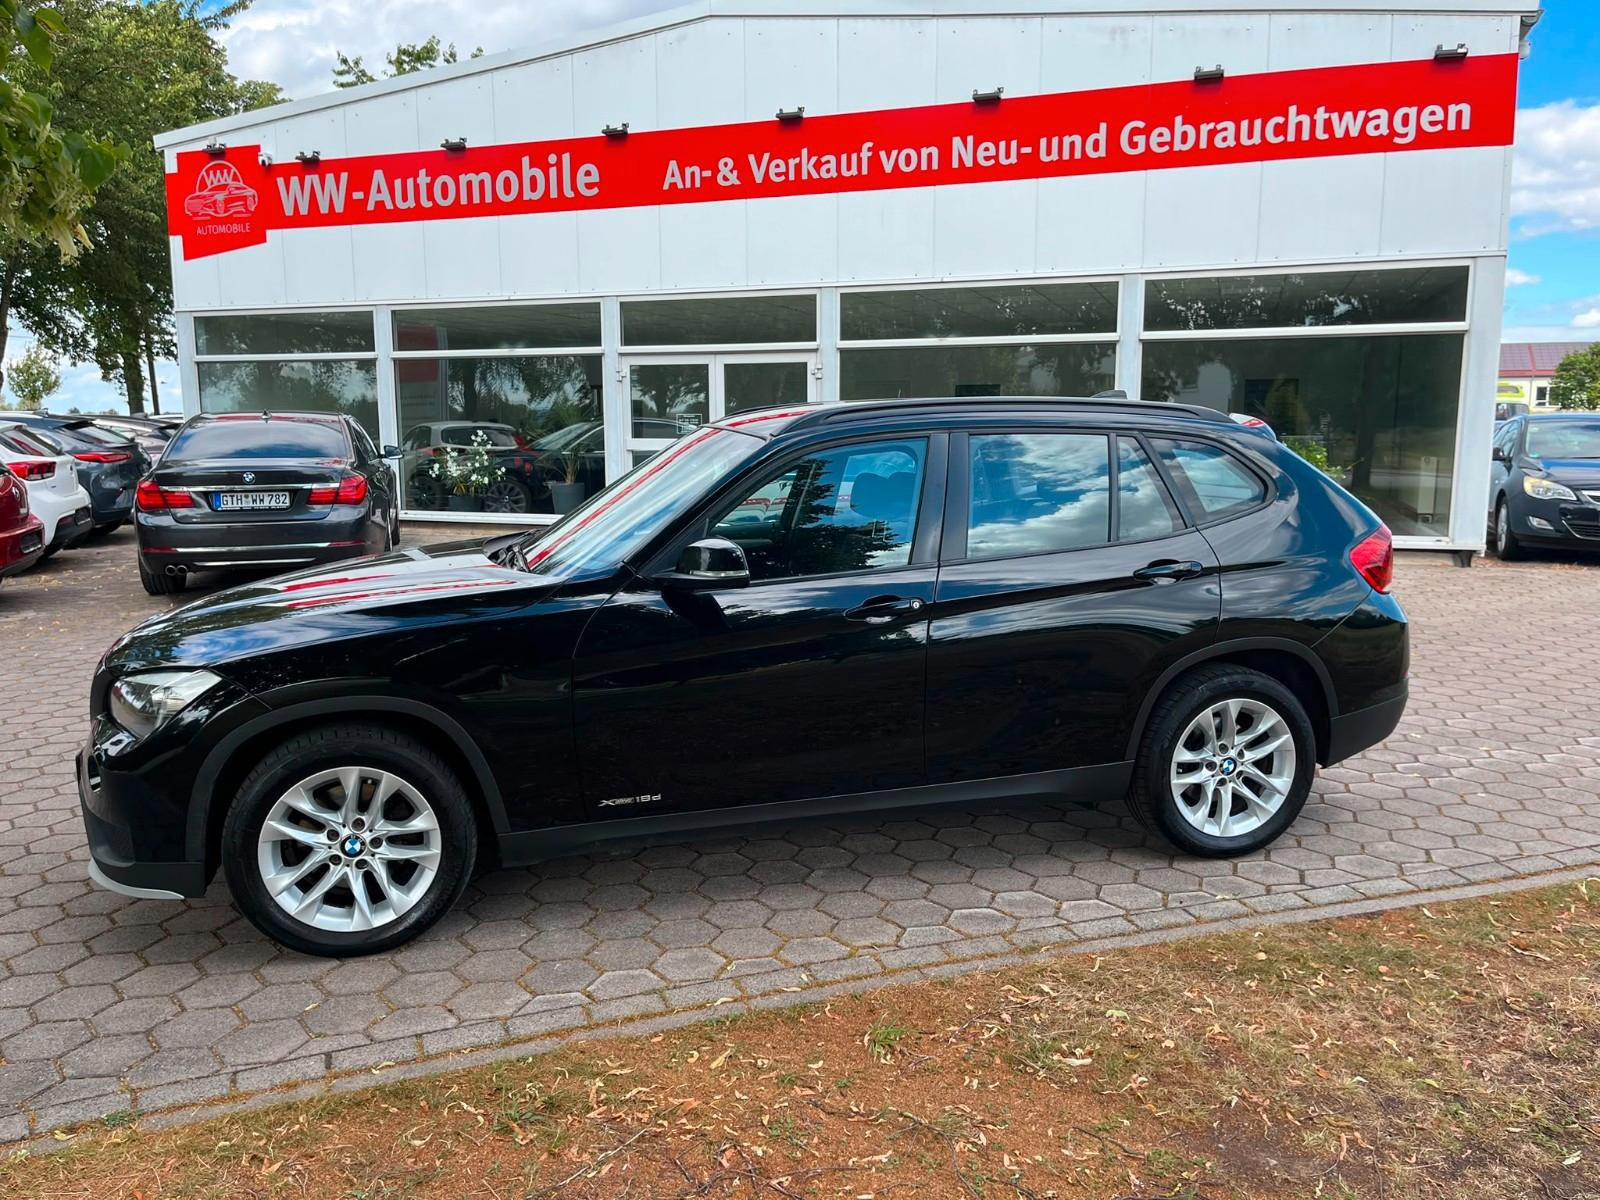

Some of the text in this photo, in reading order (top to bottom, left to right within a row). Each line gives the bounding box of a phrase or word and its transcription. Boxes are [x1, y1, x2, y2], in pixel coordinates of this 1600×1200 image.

[662, 102, 1472, 190] An- & Verkauf von Neu- und Gebrauchtwagen
[277, 152, 601, 216] WW-Automobile
[196, 223, 252, 236] AUTOMOBILE
[222, 494, 243, 505] GTH
[268, 493, 288, 504] 782
